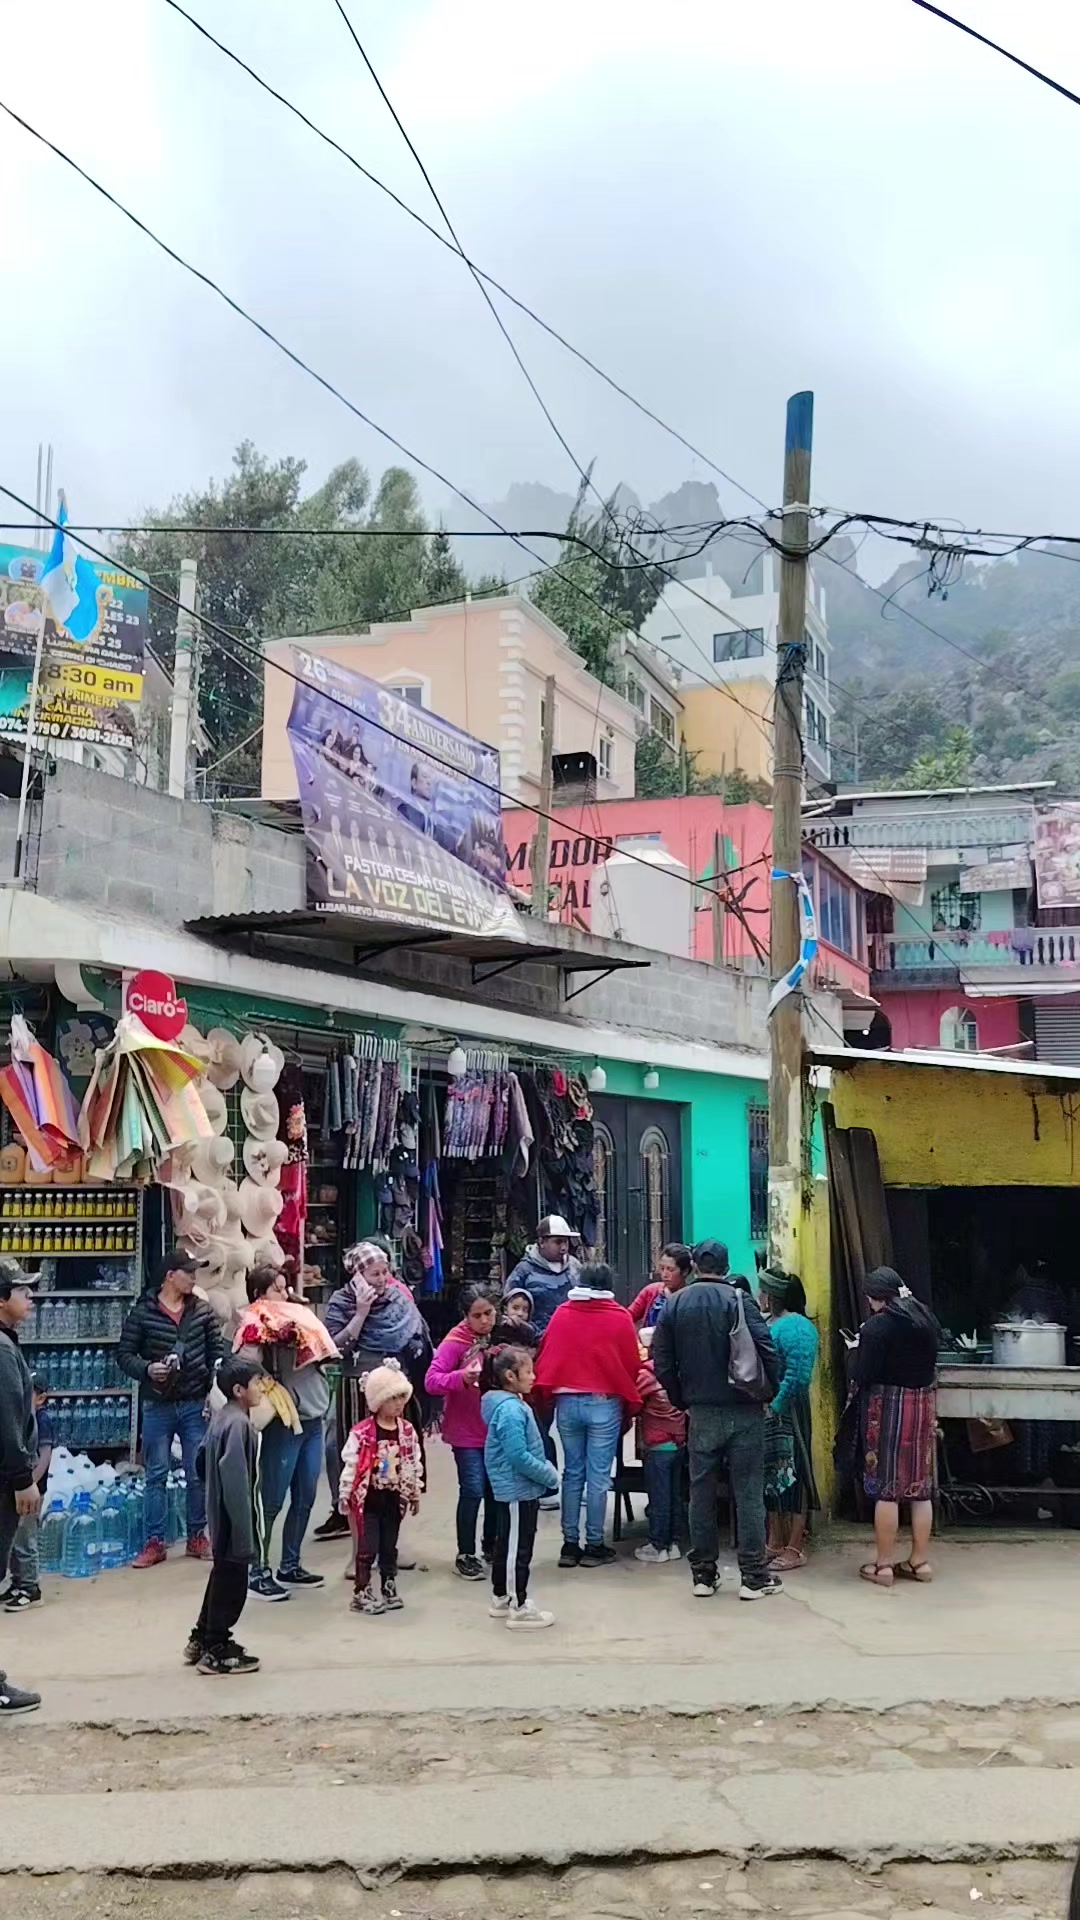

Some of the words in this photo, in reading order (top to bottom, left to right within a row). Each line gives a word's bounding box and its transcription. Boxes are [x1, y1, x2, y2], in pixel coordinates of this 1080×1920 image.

[102, 623, 118, 635] 24
[125, 613, 140, 626] 23
[107, 636, 122, 649] 25
[47, 663, 97, 687] 8:30
[103, 677, 134, 694] am
[300, 652, 327, 683] 26
[65, 687, 119, 709] PRIMERA
[343, 854, 393, 879] PASTOR
[326, 868, 364, 901] LA
[364, 875, 412, 910] VOZ
[413, 886, 451, 920] DEL
[128, 991, 177, 1018] Claro
